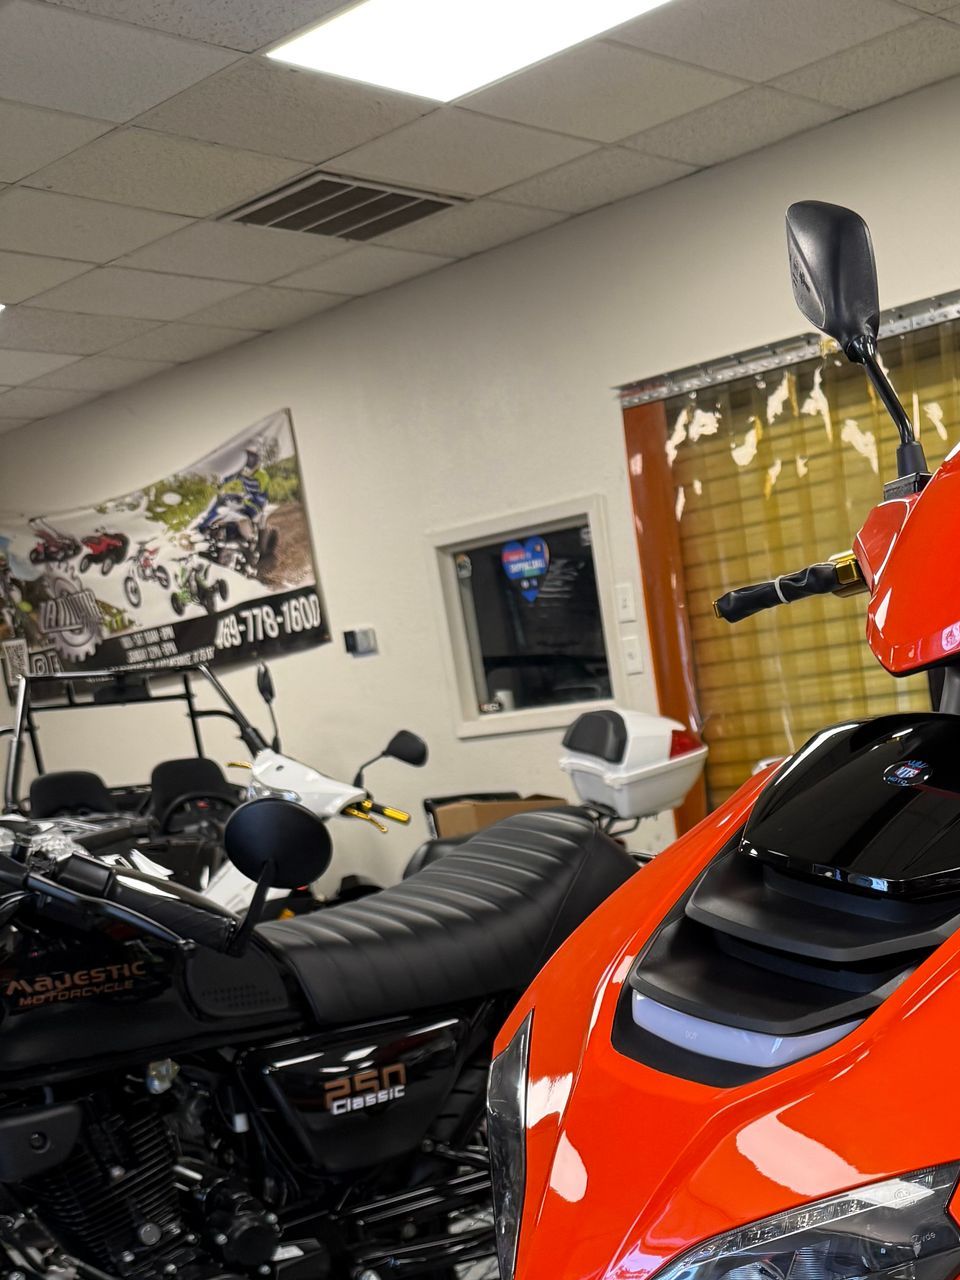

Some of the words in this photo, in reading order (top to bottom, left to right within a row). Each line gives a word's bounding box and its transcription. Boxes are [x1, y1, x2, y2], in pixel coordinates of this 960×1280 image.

[215, 593, 321, 650] 469-778-1600
[19, 979, 134, 1007] MOTORCYCLE
[324, 1063, 407, 1110] 250
[331, 1085, 405, 1116] Classic
